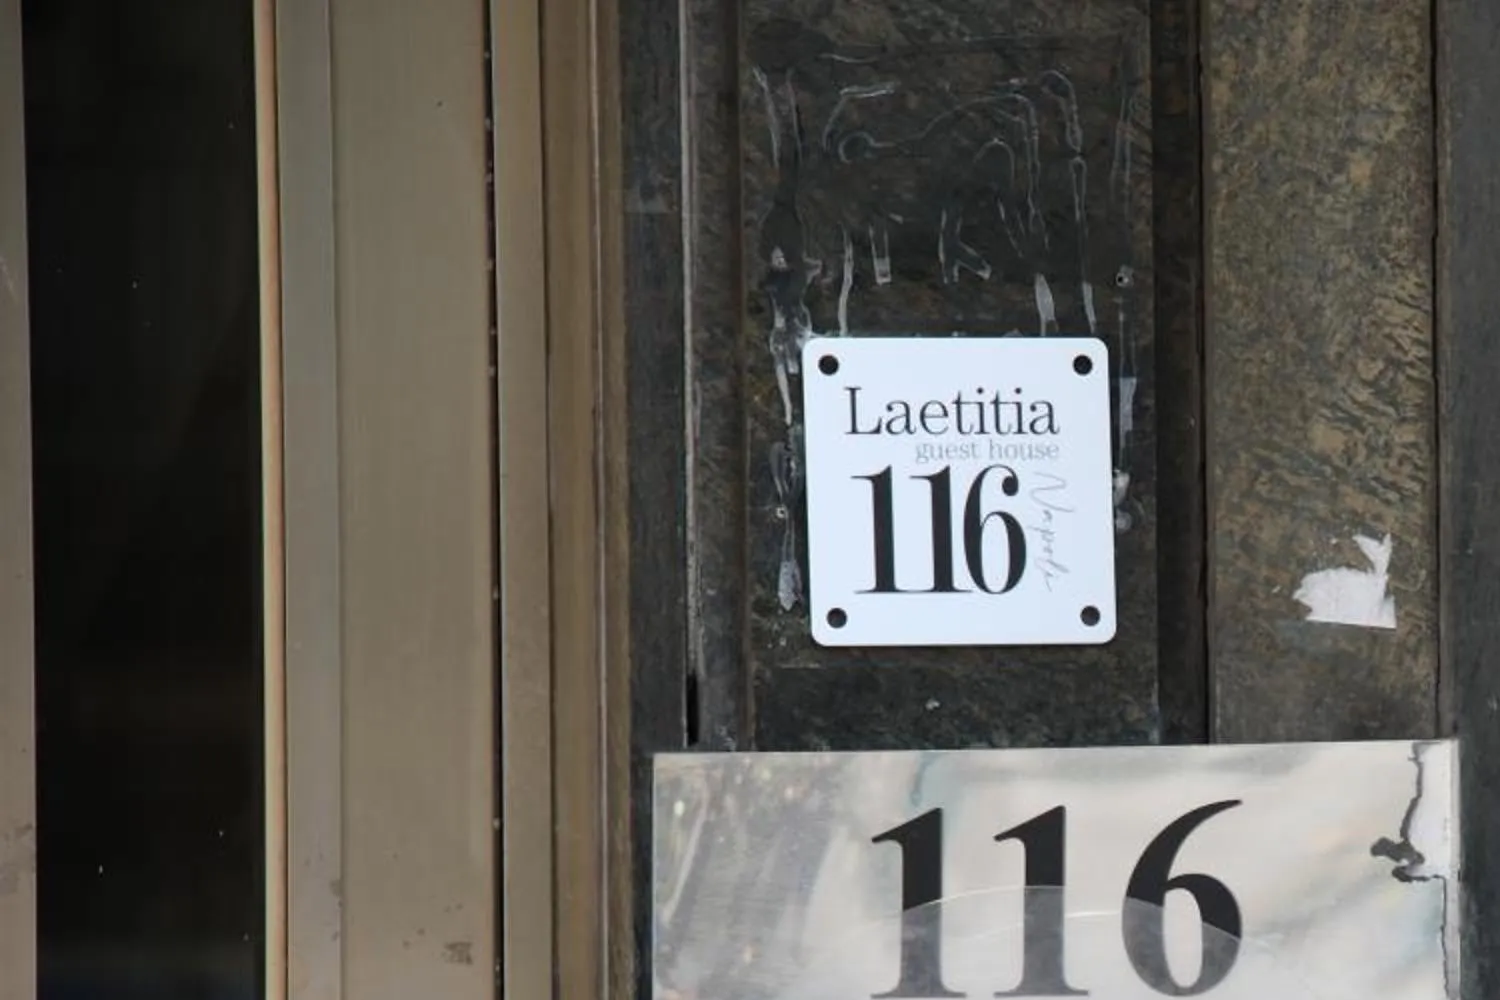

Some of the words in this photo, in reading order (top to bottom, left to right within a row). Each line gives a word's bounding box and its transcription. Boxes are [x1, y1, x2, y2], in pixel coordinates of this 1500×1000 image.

[844, 386, 1060, 436] Laetitia
[915, 441, 987, 463] guest
[988, 439, 1060, 461] house
[850, 464, 1027, 595] 116
[870, 799, 1243, 998] 116
